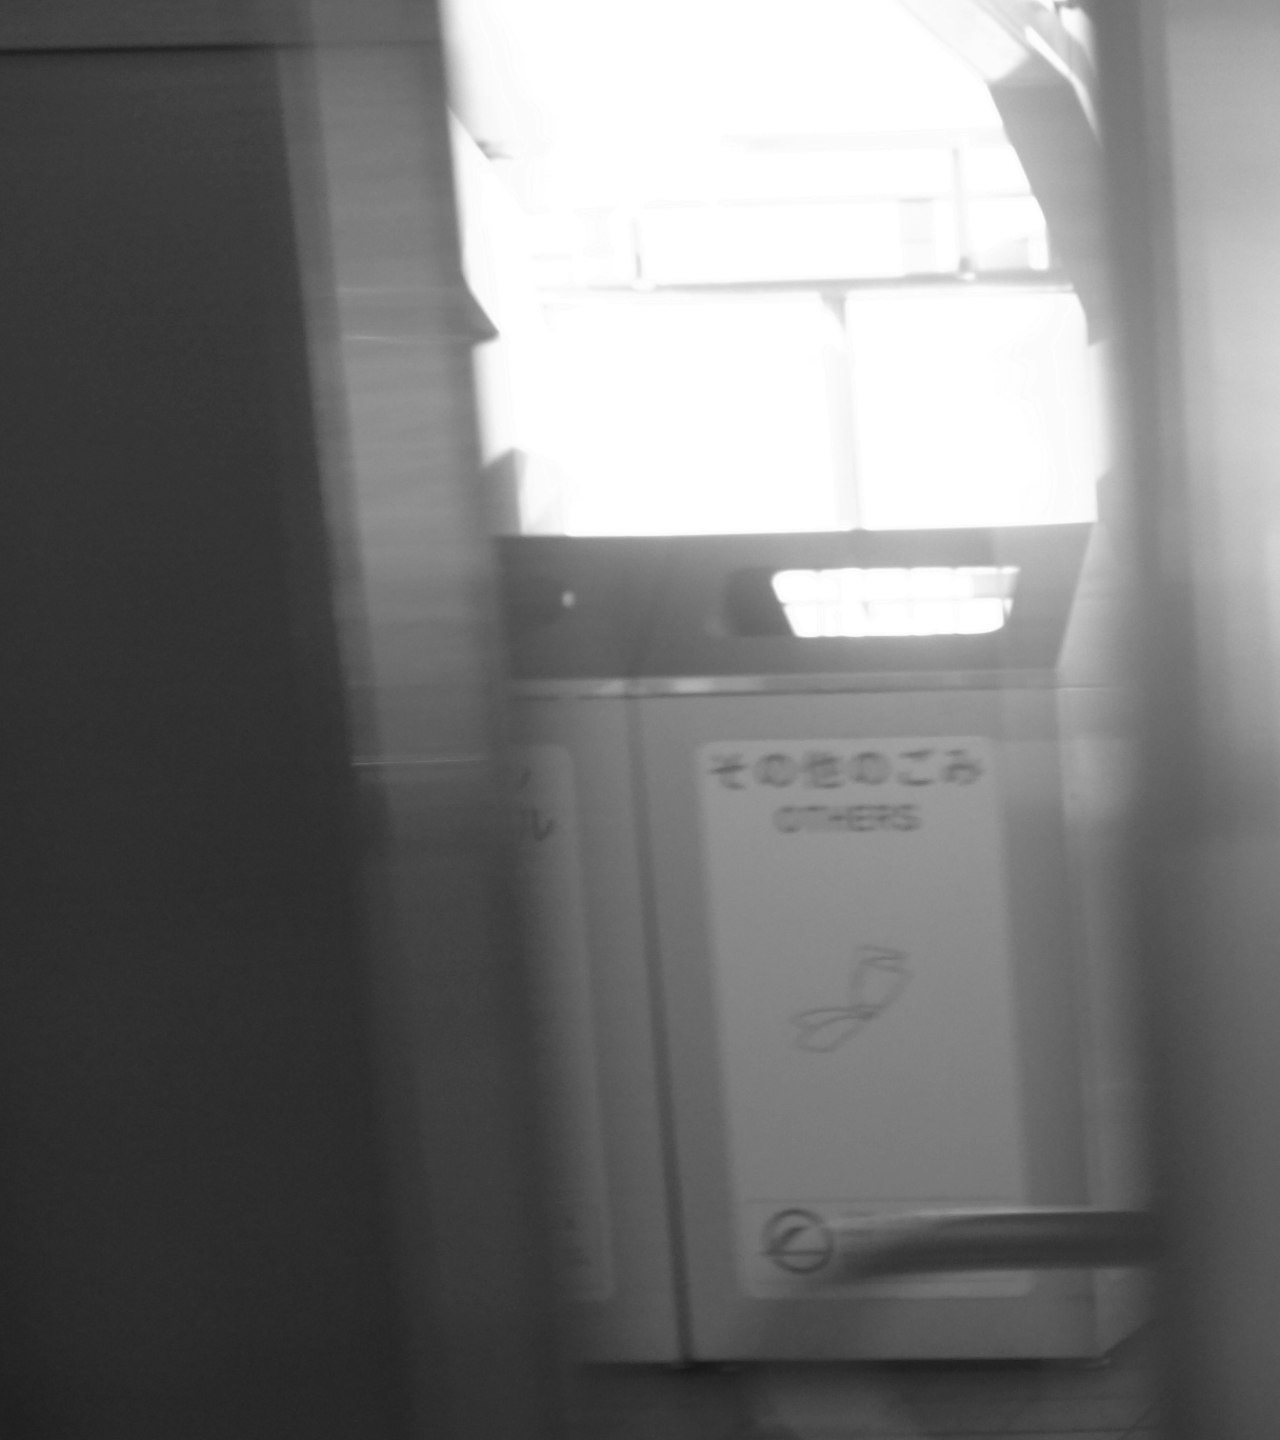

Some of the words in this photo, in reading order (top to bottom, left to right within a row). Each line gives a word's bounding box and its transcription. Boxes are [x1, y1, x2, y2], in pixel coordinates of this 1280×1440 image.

[709, 748, 984, 791] その他のごみ
[772, 803, 923, 833] OTHERS
